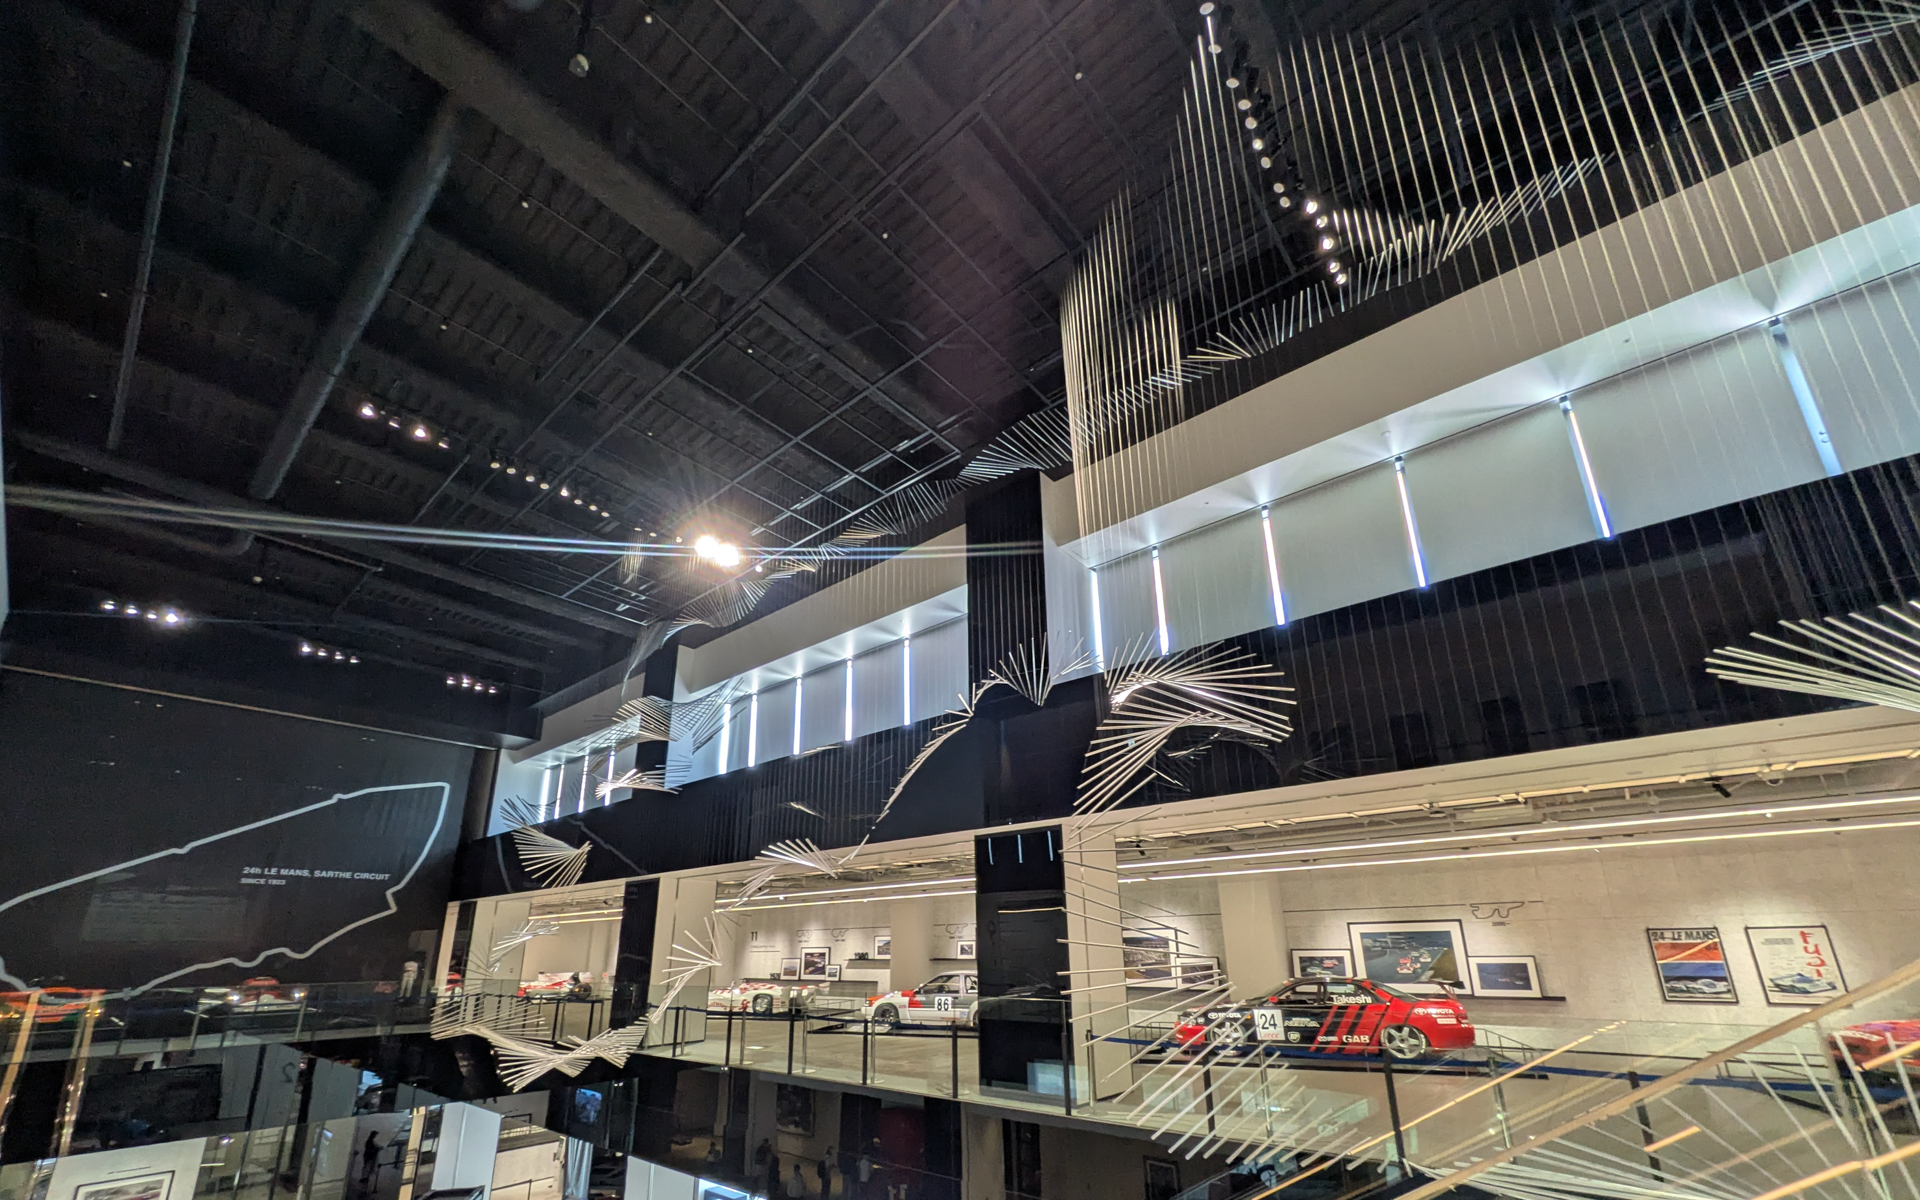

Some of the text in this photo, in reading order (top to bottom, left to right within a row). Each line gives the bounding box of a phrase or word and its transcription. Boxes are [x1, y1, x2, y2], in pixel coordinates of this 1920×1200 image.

[243, 866, 390, 881] 24h LE MANS, SARTHE CIRCUIT
[240, 877, 266, 885] SINCE
[1684, 930, 1717, 941] MANS
[936, 998, 950, 1011] 86
[1330, 994, 1372, 1005] Takeshi
[1259, 1013, 1278, 1030] 24
[1342, 1034, 1370, 1043] GAB
